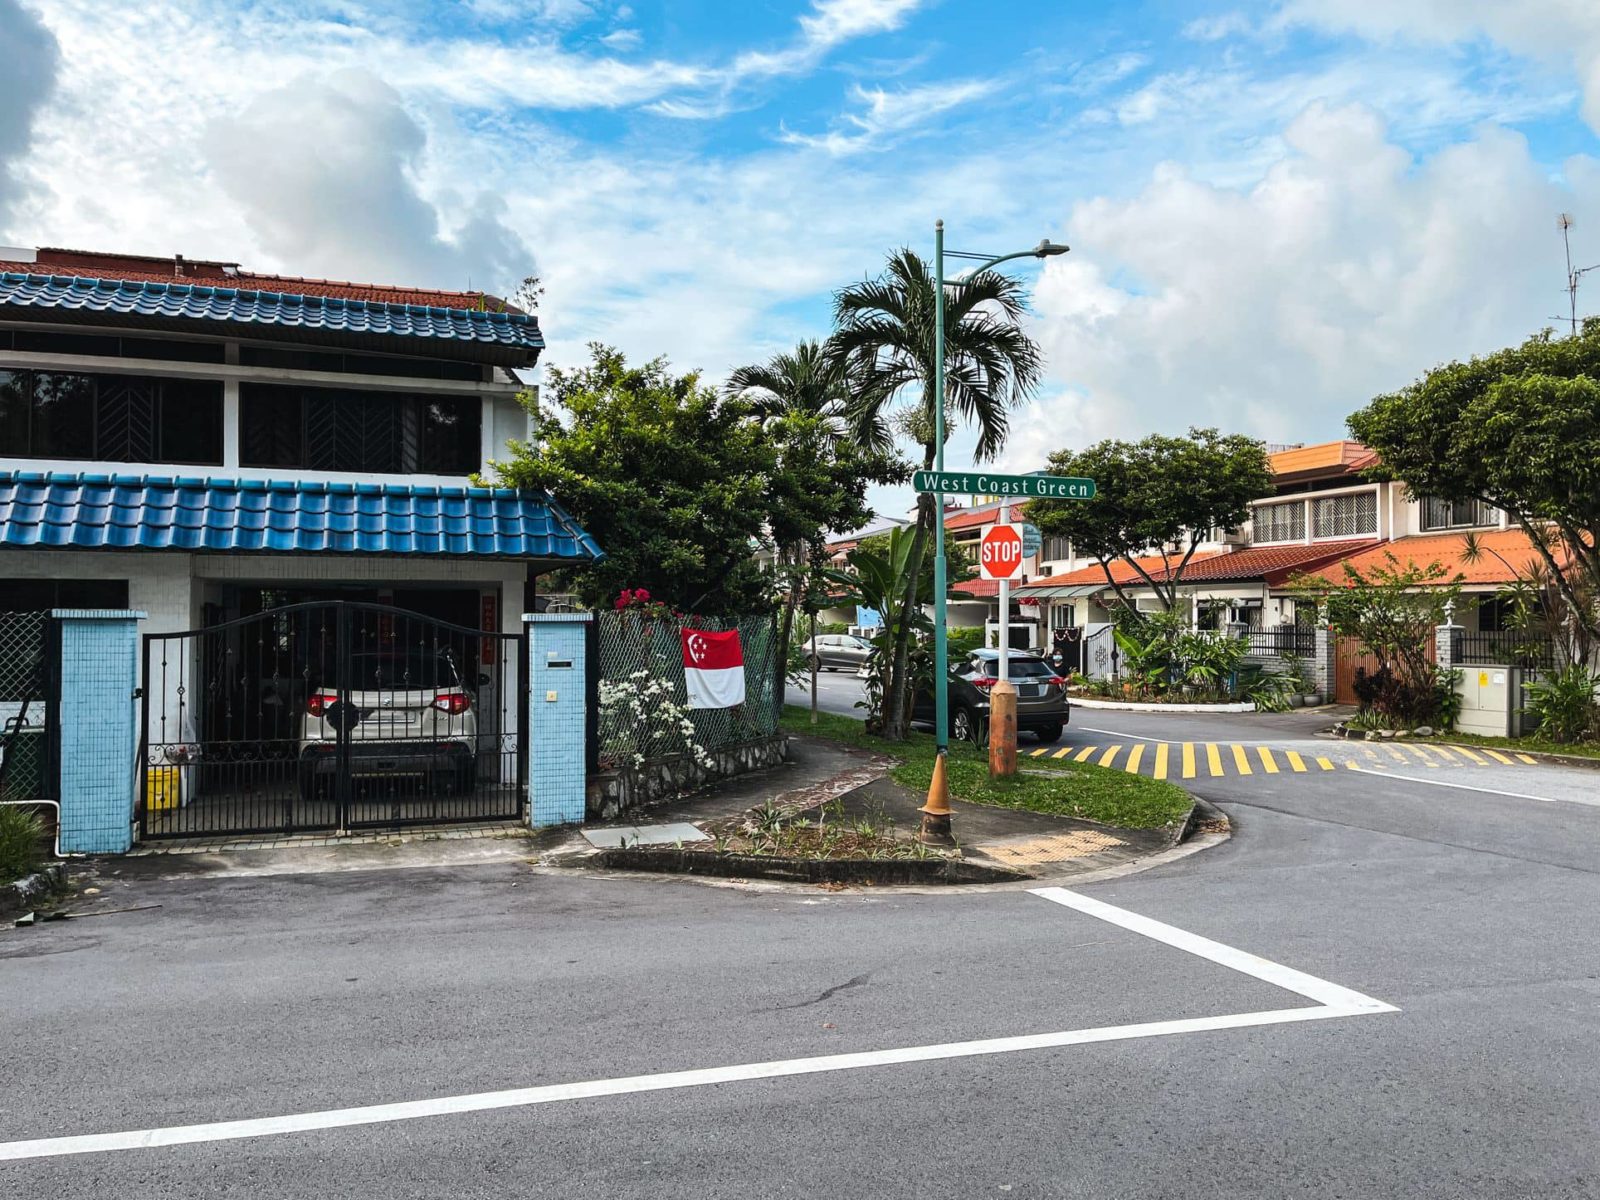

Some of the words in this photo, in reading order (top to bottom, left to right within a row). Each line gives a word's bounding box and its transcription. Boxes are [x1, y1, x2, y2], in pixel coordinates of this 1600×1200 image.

[923, 474, 969, 492] West
[977, 476, 1028, 494] Coast
[1036, 478, 1088, 497] Green
[983, 541, 1021, 563] STOP
